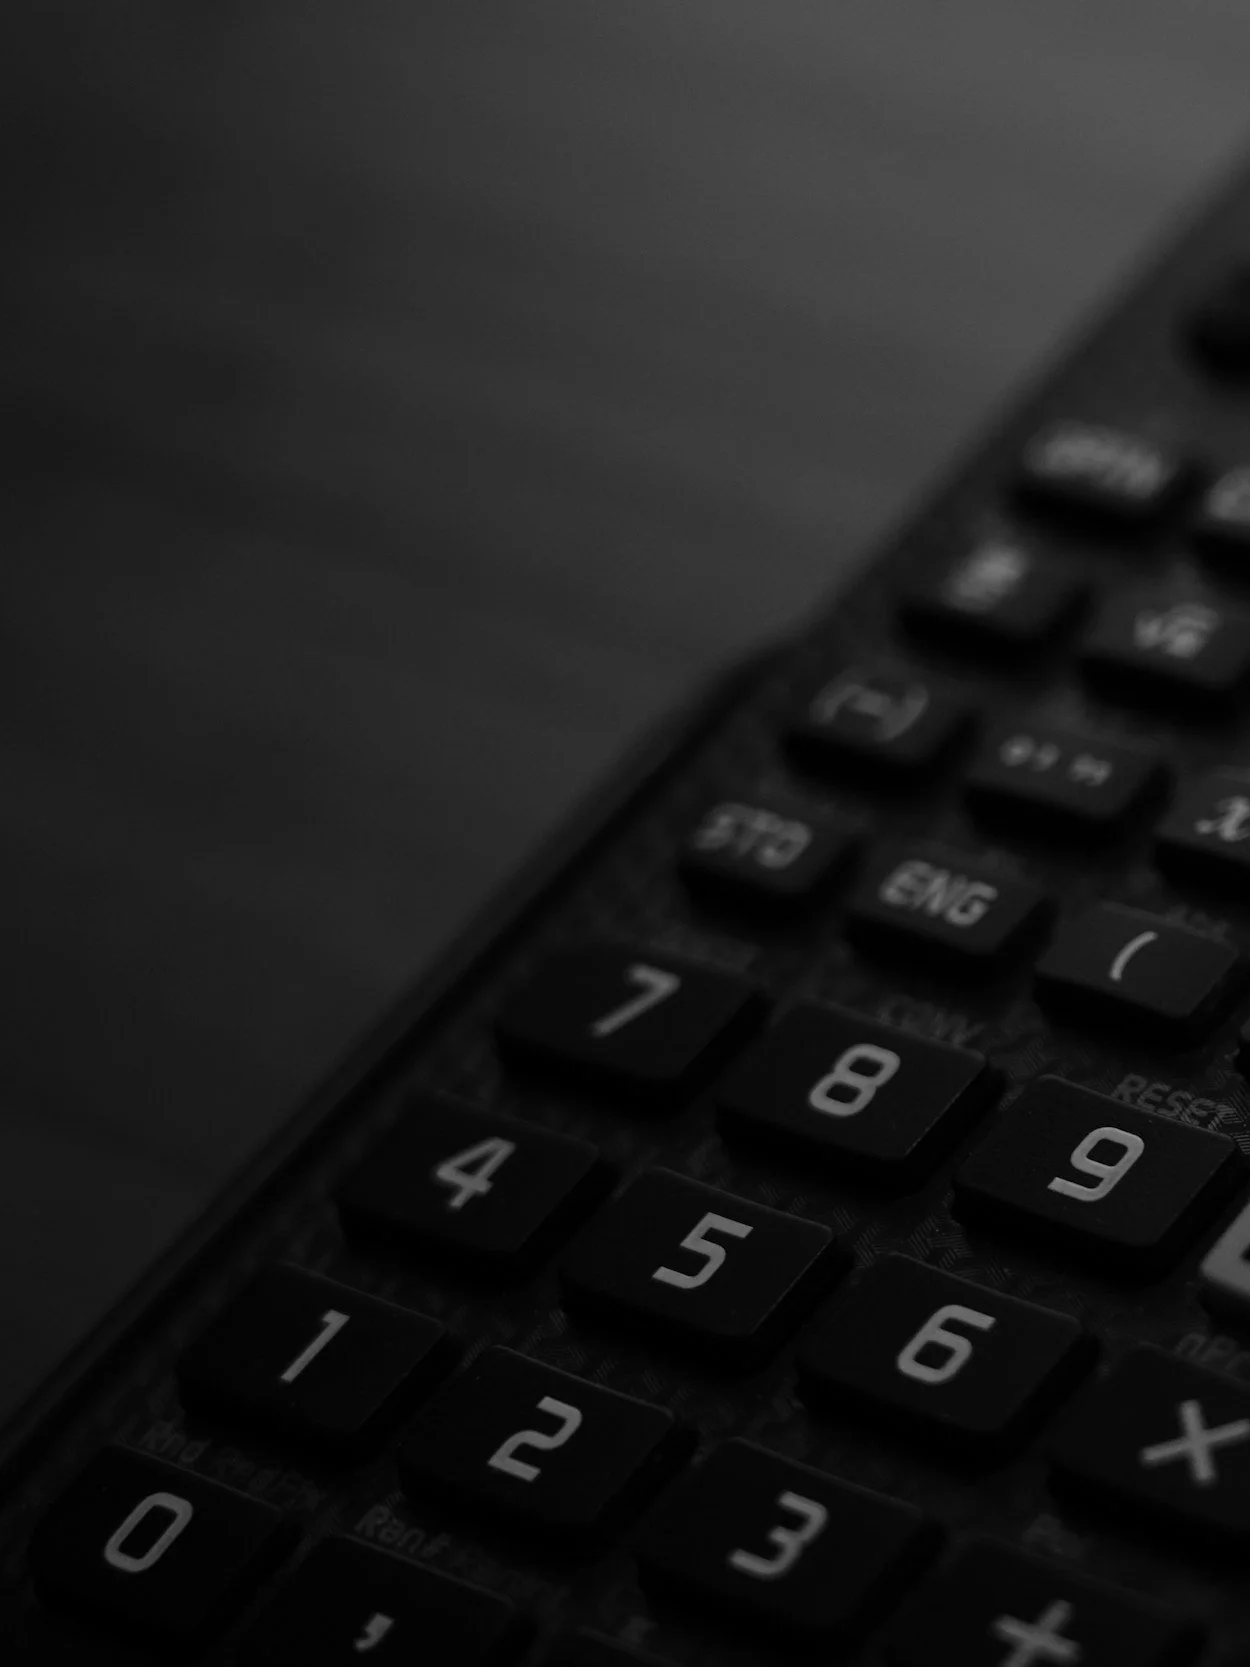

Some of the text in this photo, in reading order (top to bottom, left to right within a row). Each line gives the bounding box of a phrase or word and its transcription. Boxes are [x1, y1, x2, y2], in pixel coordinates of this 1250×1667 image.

[878, 858, 999, 928] ENG
[587, 962, 681, 1038] 7
[807, 1043, 901, 1118] 8
[1109, 1072, 1237, 1132] RESET
[430, 1136, 516, 1213] 4
[1046, 1126, 1145, 1202] 9
[651, 1211, 755, 1289] 5
[277, 1308, 350, 1383] 1
[895, 1303, 997, 1386] 6
[486, 1395, 583, 1483] 2
[102, 1491, 194, 1575] 0
[725, 1487, 830, 1582] 3
